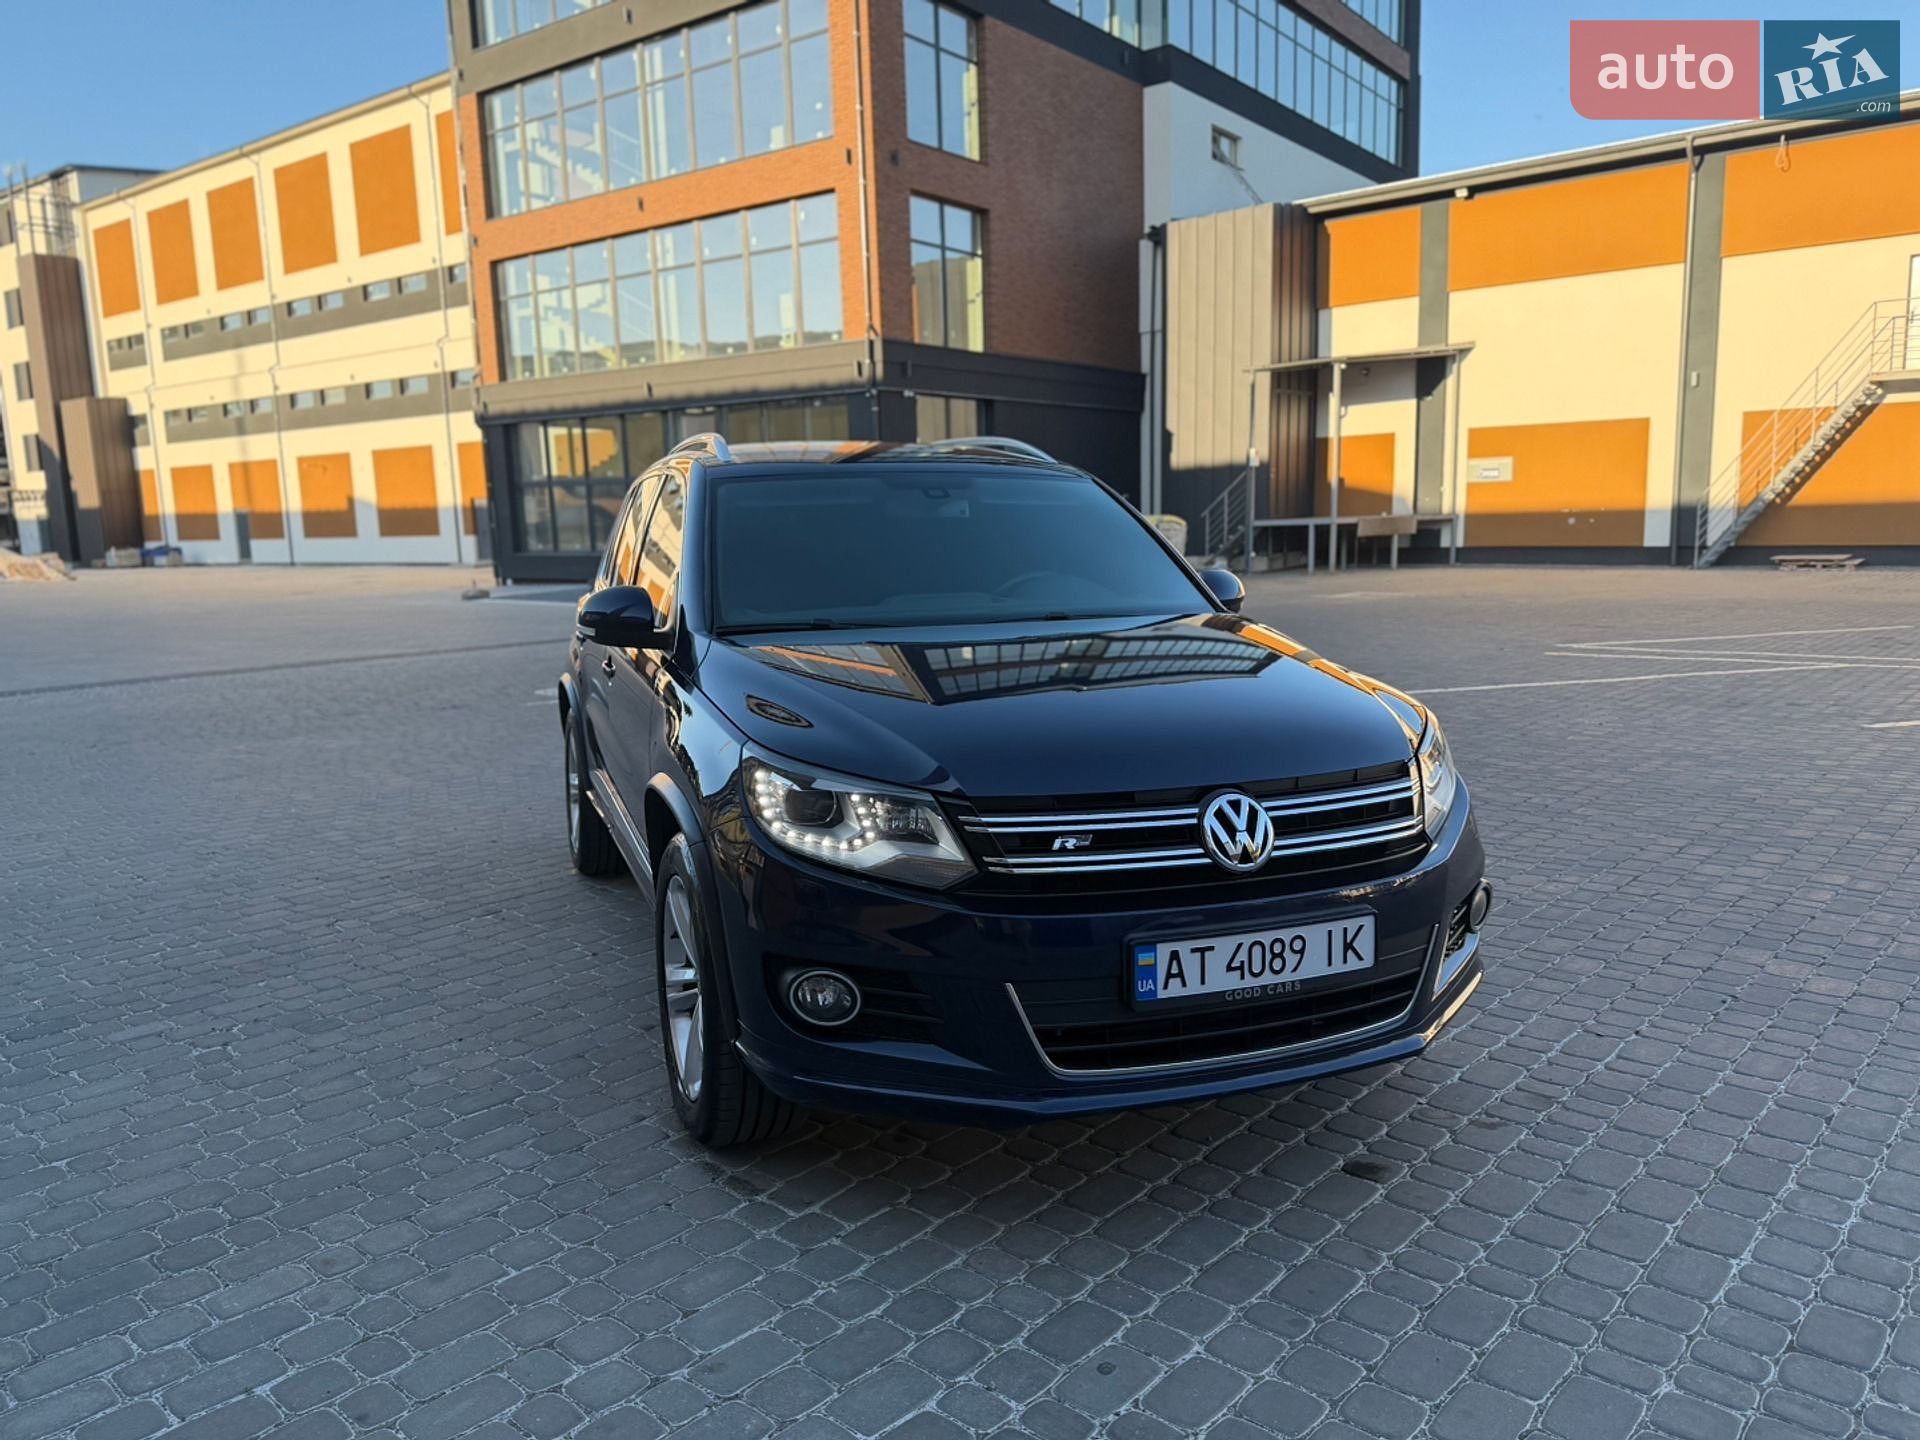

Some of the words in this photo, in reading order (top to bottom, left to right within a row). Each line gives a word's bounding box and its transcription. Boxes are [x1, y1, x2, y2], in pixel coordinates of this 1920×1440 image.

[1162, 946, 1215, 990] AT
[1225, 935, 1307, 980] 4089
[1327, 924, 1365, 967] IK
[1138, 979, 1155, 992] UA
[1225, 987, 1261, 1001] GOOD
[1267, 981, 1301, 995] CARS
